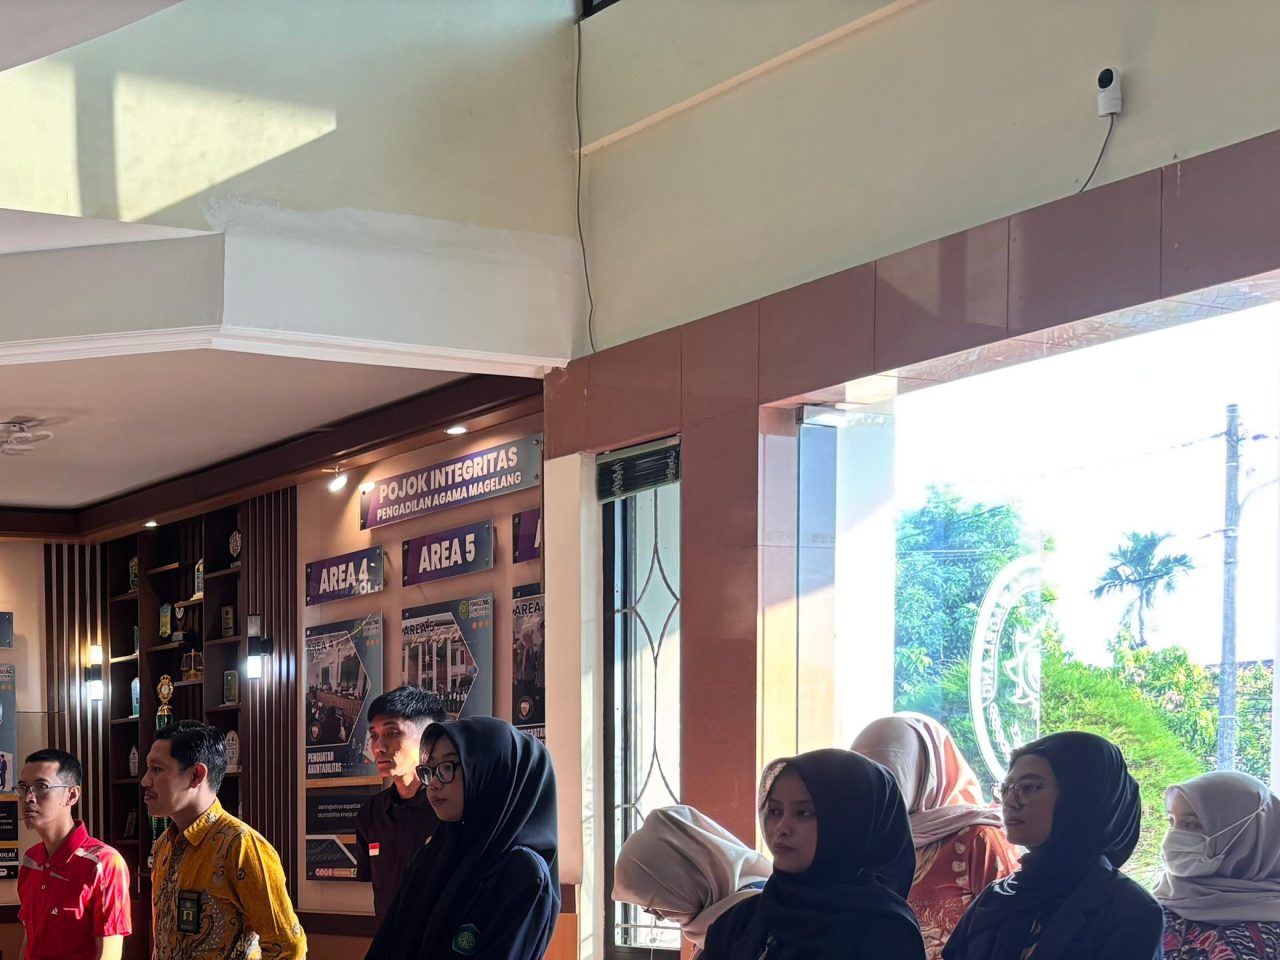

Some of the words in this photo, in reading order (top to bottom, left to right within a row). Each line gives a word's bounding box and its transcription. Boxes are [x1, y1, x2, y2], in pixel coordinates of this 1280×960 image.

[379, 473, 428, 503] POJOK
[430, 446, 518, 490] INTEGRITAS
[376, 495, 433, 521] PENGADILAN
[432, 487, 468, 506] AGAMA
[468, 471, 522, 497] MAGELANG
[419, 538, 463, 574] AREA
[465, 533, 476, 562] 5
[319, 561, 356, 594] AREA
[358, 558, 368, 583] 4
[514, 602, 542, 616] AREA
[403, 623, 427, 637] AREA
[429, 621, 435, 632] 5
